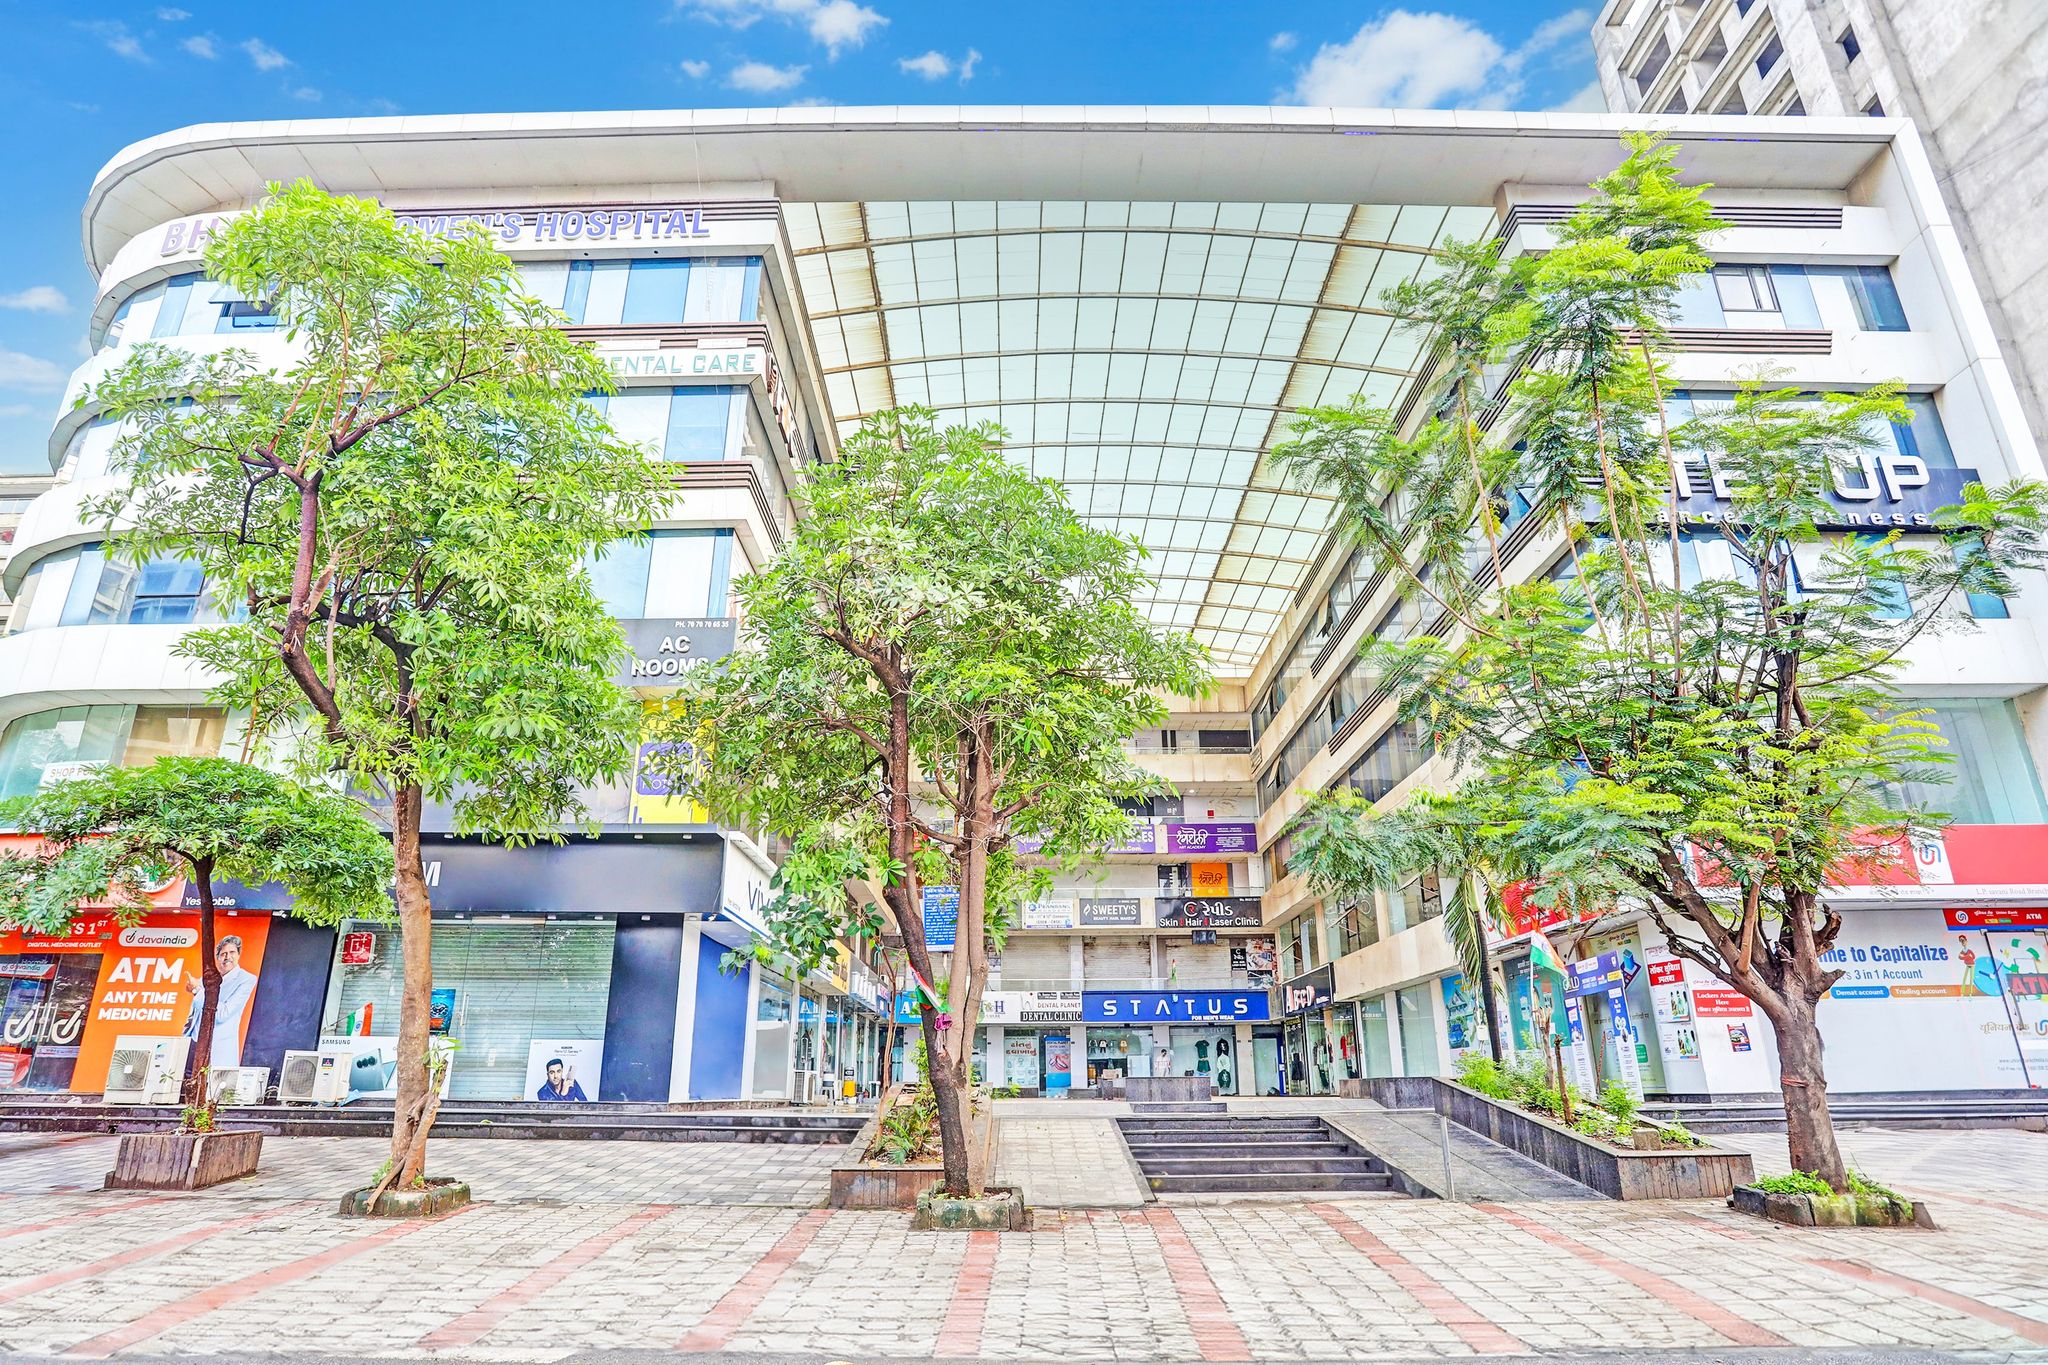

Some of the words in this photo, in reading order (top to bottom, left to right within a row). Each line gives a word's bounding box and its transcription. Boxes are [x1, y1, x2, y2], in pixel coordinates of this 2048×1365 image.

[535, 209, 711, 241] HOSPITAL
[604, 355, 682, 374] ENTAL
[693, 354, 756, 373] CARE
[659, 636, 692, 654] AC
[50, 768, 75, 778] SHOP
[77, 767, 95, 777] FO
[1092, 905, 1137, 915] SWEETY'S
[1160, 918, 1178, 926] Skin
[1185, 918, 1202, 926] Hair
[1210, 918, 1233, 926] Laser
[1235, 917, 1259, 926] Clinic
[138, 935, 187, 945] davaindia
[1850, 947, 1867, 961] to
[1870, 945, 1949, 963] Capitalize
[107, 957, 184, 983] ATM
[1855, 969, 1861, 979] 3
[1863, 969, 1873, 979] in
[1875, 970, 1880, 979] 1
[1883, 969, 1923, 979] Account
[103, 992, 139, 1004] ANY
[140, 992, 178, 1004] TIME
[1895, 988, 1920, 997] Trading
[1103, 998, 1249, 1016] STATUS
[98, 1008, 174, 1021] MEDICINE
[1022, 1011, 1054, 1021] DENTAL
[1055, 1011, 1082, 1021] CLINIC
